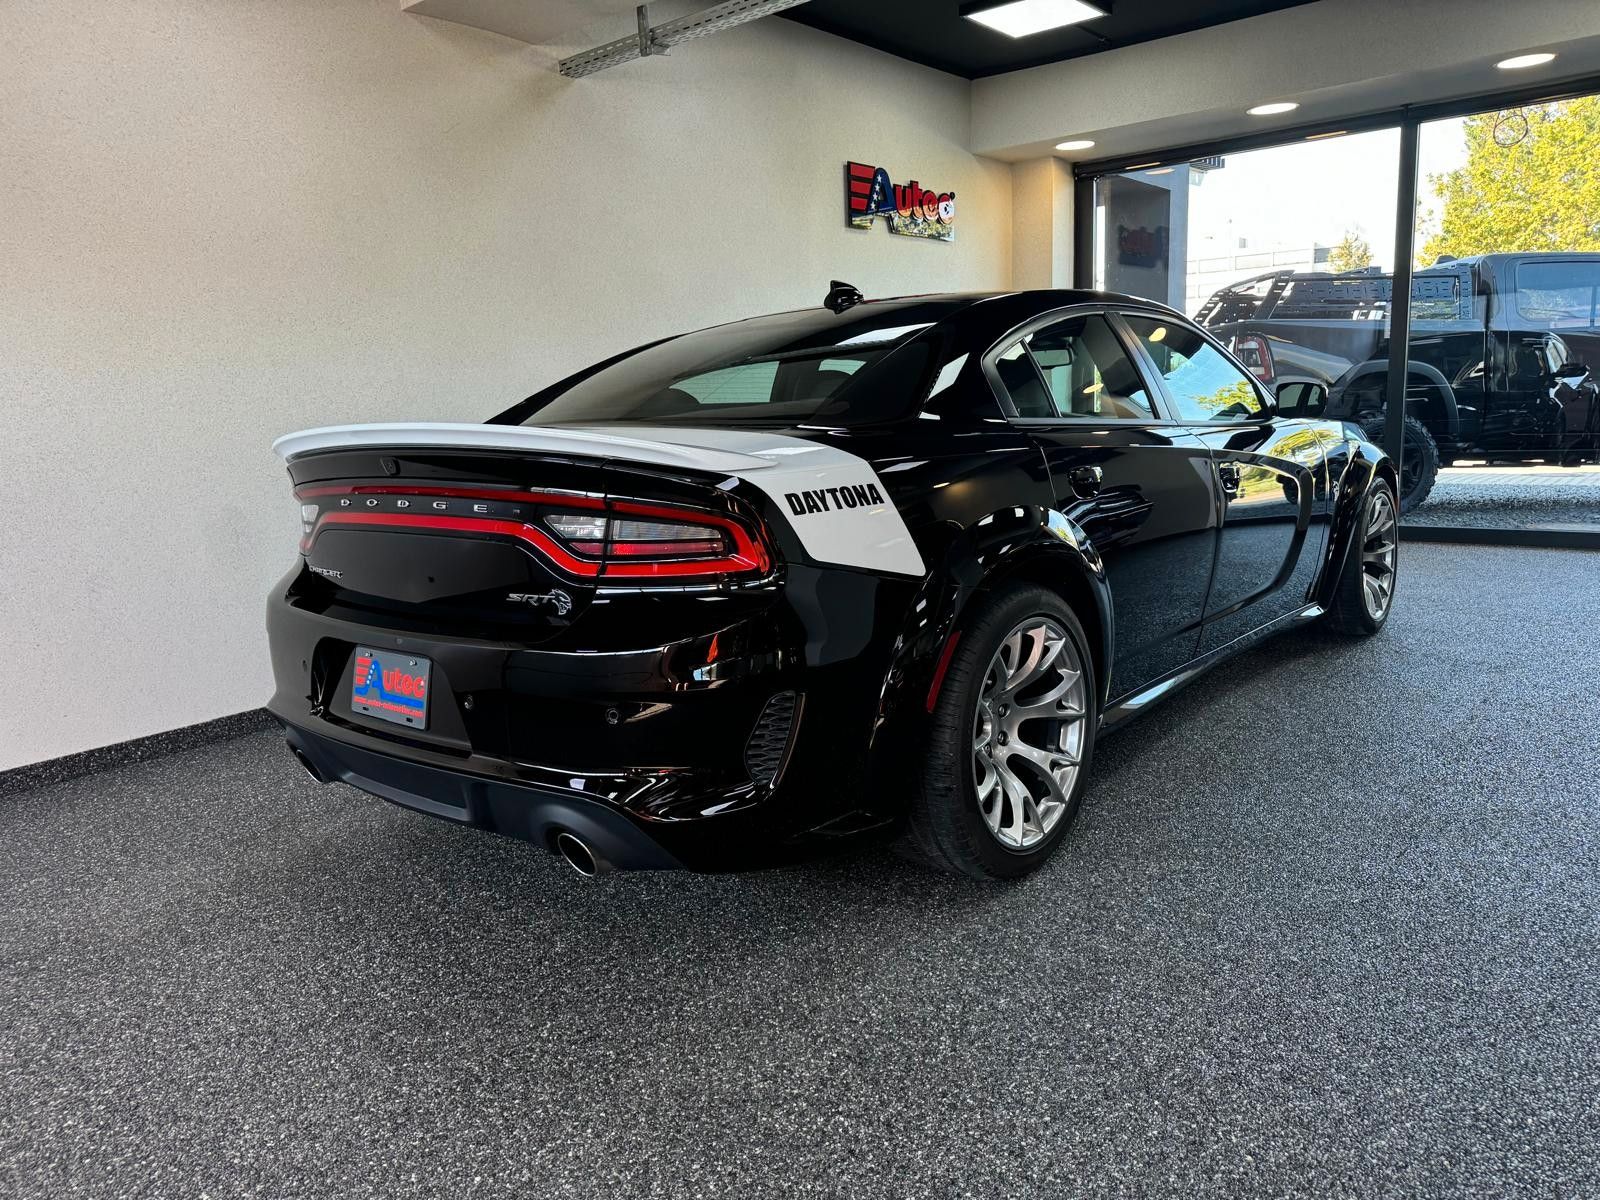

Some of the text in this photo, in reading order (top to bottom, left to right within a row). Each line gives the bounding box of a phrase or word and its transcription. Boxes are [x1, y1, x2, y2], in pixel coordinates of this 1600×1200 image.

[862, 166, 955, 230] Autec
[340, 499, 488, 513] DODGE
[784, 483, 885, 516] DAYTONA
[505, 593, 555, 606] SRT
